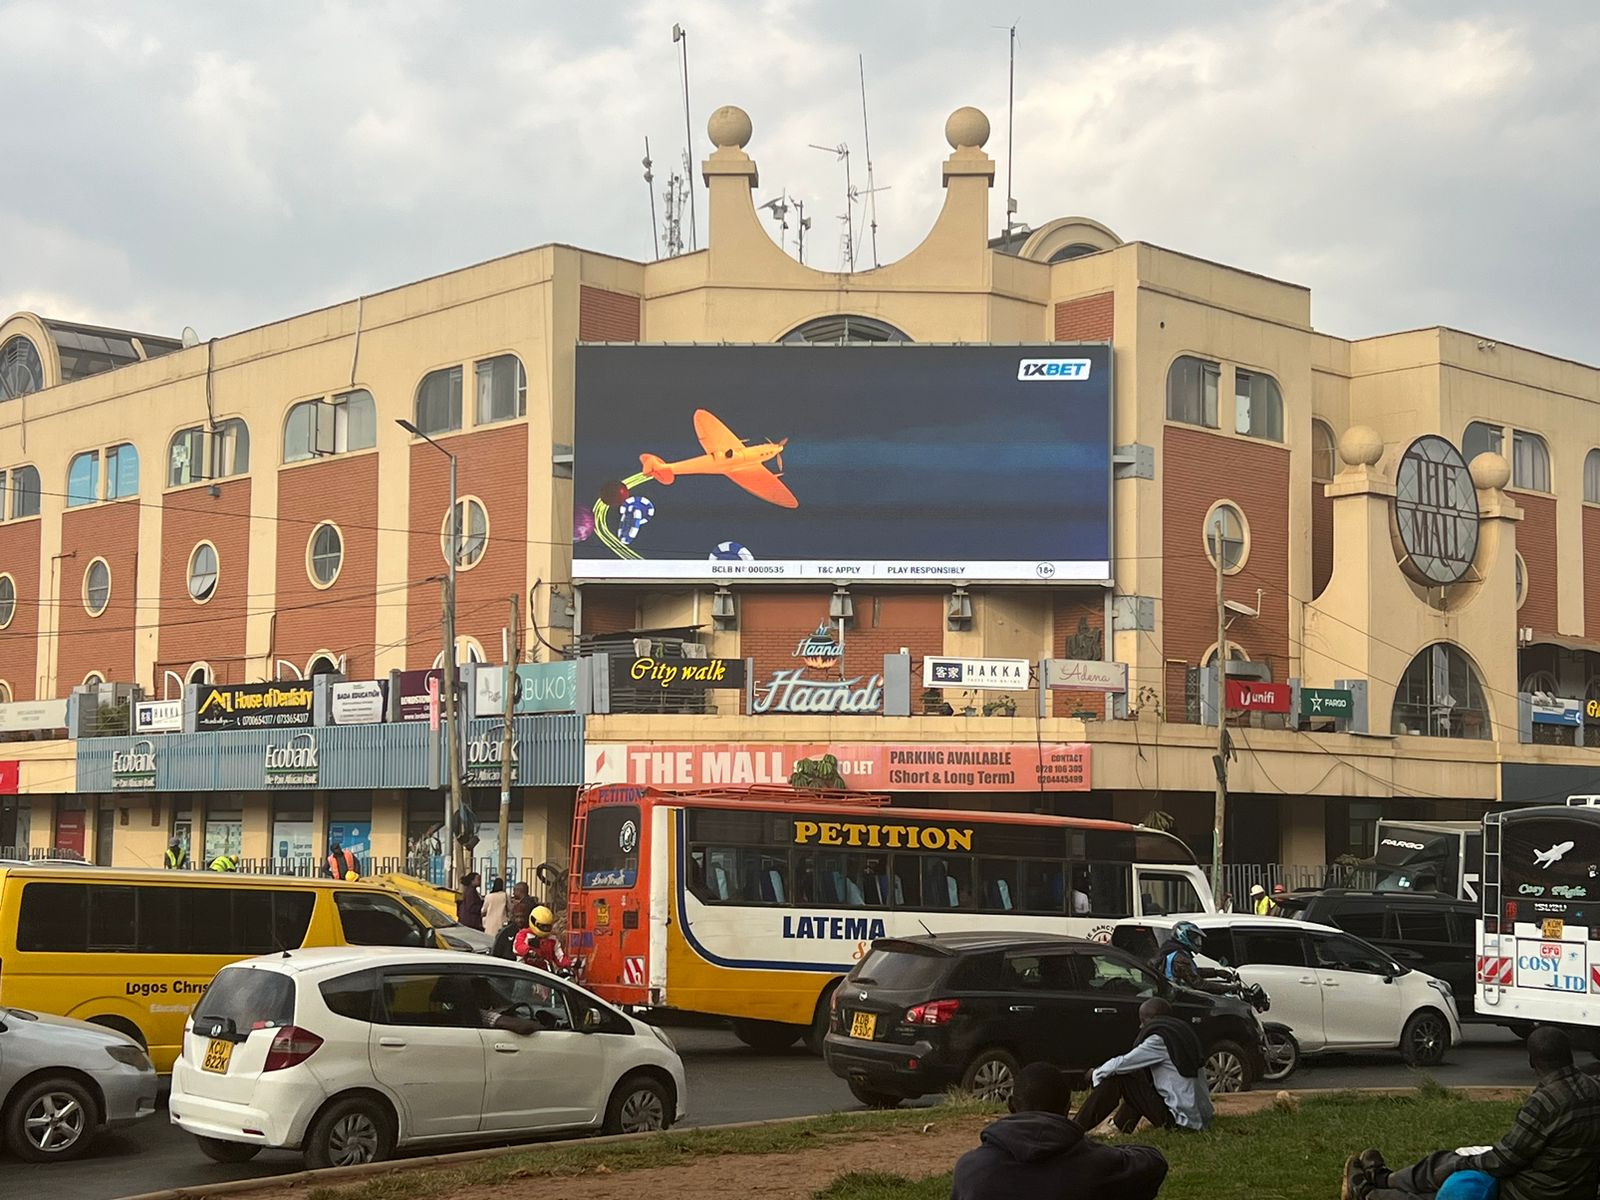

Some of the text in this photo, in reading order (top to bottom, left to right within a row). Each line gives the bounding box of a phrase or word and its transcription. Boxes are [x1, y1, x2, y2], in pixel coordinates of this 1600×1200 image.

[1023, 363, 1086, 376] 1XBET
[1405, 453, 1458, 508] THE
[1411, 509, 1466, 567] MALL
[711, 566, 732, 574] BCLB
[748, 566, 784, 574] 0000535
[817, 566, 860, 574] T&C APPLY
[887, 566, 965, 574] PLAY RESPONSIBLY
[1038, 566, 1053, 574] 18+
[630, 658, 726, 687] City walk
[967, 665, 1021, 678] HAKKA
[1059, 663, 1110, 682] Adena
[505, 676, 566, 701] BUKO
[754, 667, 881, 713] Haandi
[235, 691, 263, 709] House
[273, 687, 313, 711] Dentistry
[1325, 699, 1346, 708] FARGO
[112, 740, 156, 772] Ecobank
[265, 733, 318, 768] Ecobank
[890, 751, 1012, 765] PARKING AVAILABLE
[1051, 754, 1083, 762] CONTACT
[630, 752, 693, 784] THE
[702, 752, 787, 784] MALL
[854, 760, 874, 774] LET
[889, 770, 1015, 785] (Short & Long Term)
[598, 787, 642, 803] PETITION
[793, 821, 974, 852] PETITION
[1381, 839, 1425, 850] FARGO
[783, 916, 886, 940] LATEMA
[1518, 956, 1560, 972] COSY
[126, 982, 168, 996] Logos
[1553, 974, 1585, 991] LTD
[208, 1040, 227, 1056] KCU
[204, 1054, 227, 1070] 822K
